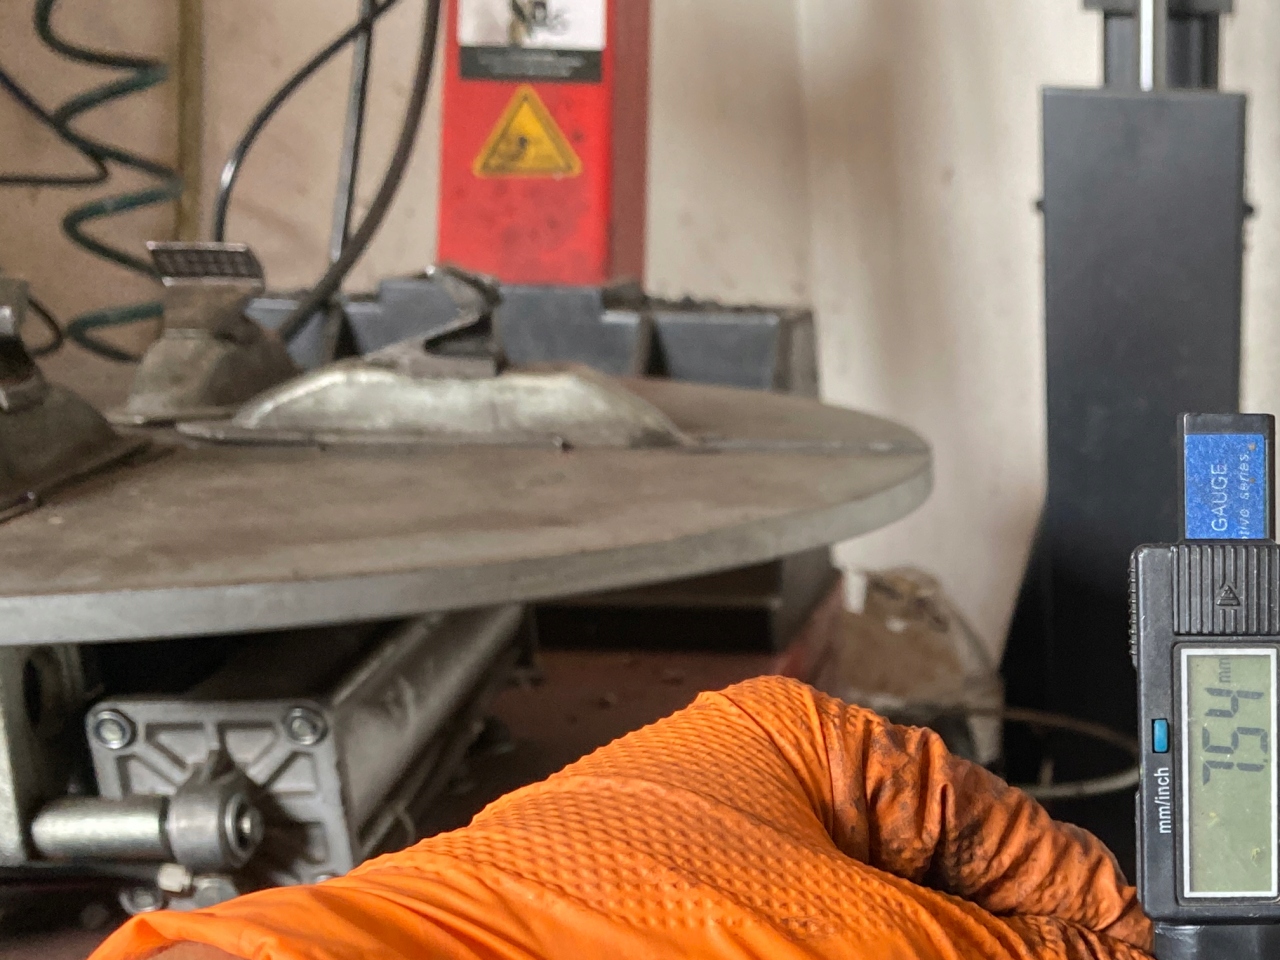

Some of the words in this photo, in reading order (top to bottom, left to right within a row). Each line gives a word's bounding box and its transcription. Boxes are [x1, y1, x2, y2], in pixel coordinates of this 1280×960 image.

[1211, 464, 1228, 532] GAUGE
[1218, 657, 1231, 684] mm
[1154, 767, 1172, 834] mm/inch
